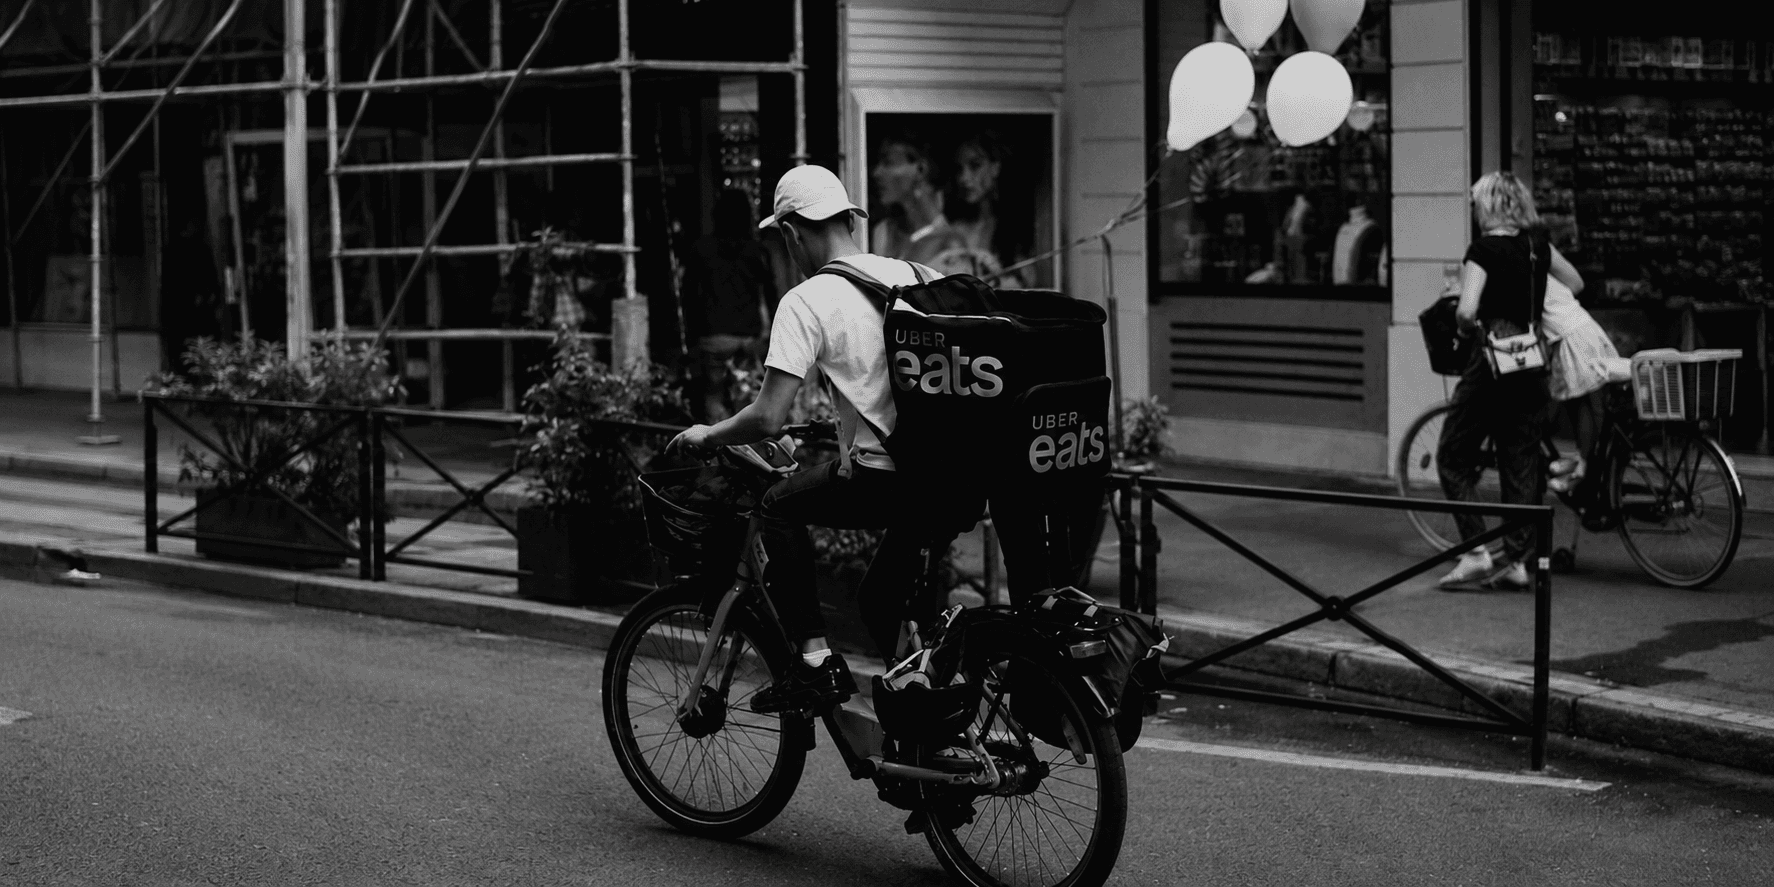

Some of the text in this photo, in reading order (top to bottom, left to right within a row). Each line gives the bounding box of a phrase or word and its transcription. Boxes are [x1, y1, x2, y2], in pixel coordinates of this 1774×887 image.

[895, 328, 946, 349] UBER
[893, 345, 1004, 398] eats
[1032, 411, 1078, 430] UBER
[1029, 421, 1105, 474] eats
